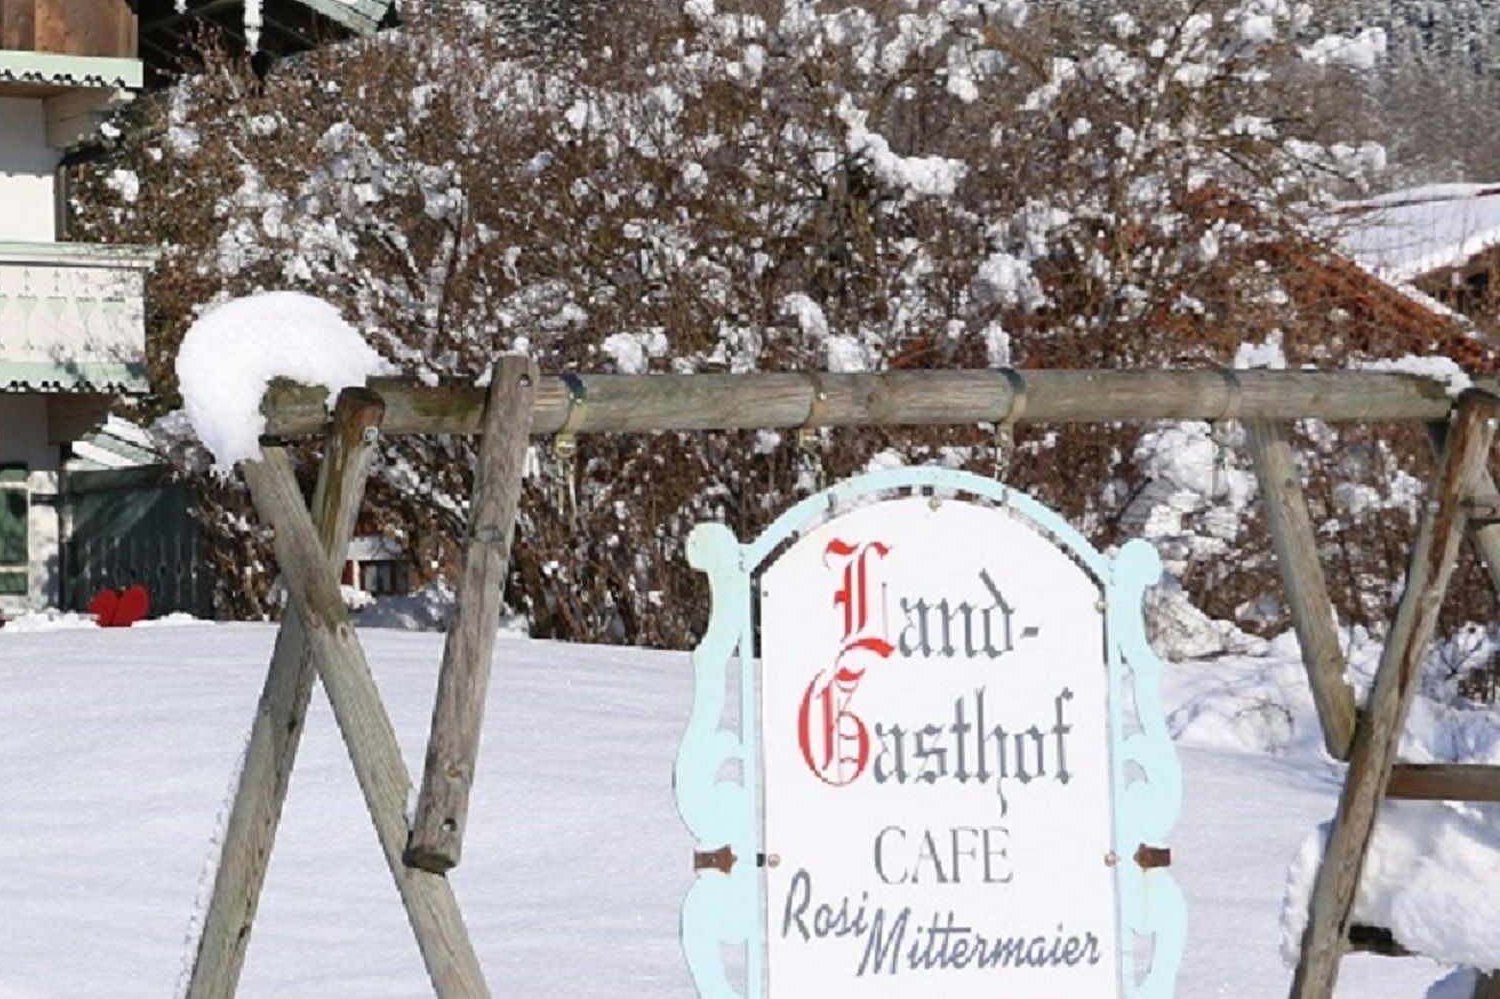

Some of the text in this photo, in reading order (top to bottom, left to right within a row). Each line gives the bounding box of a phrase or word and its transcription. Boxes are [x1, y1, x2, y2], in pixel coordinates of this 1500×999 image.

[823, 537, 1040, 662] Land-
[798, 666, 1074, 816] Gasthof
[873, 825, 1014, 885] CAFE
[781, 867, 1100, 977] Rosi Mittermaier
